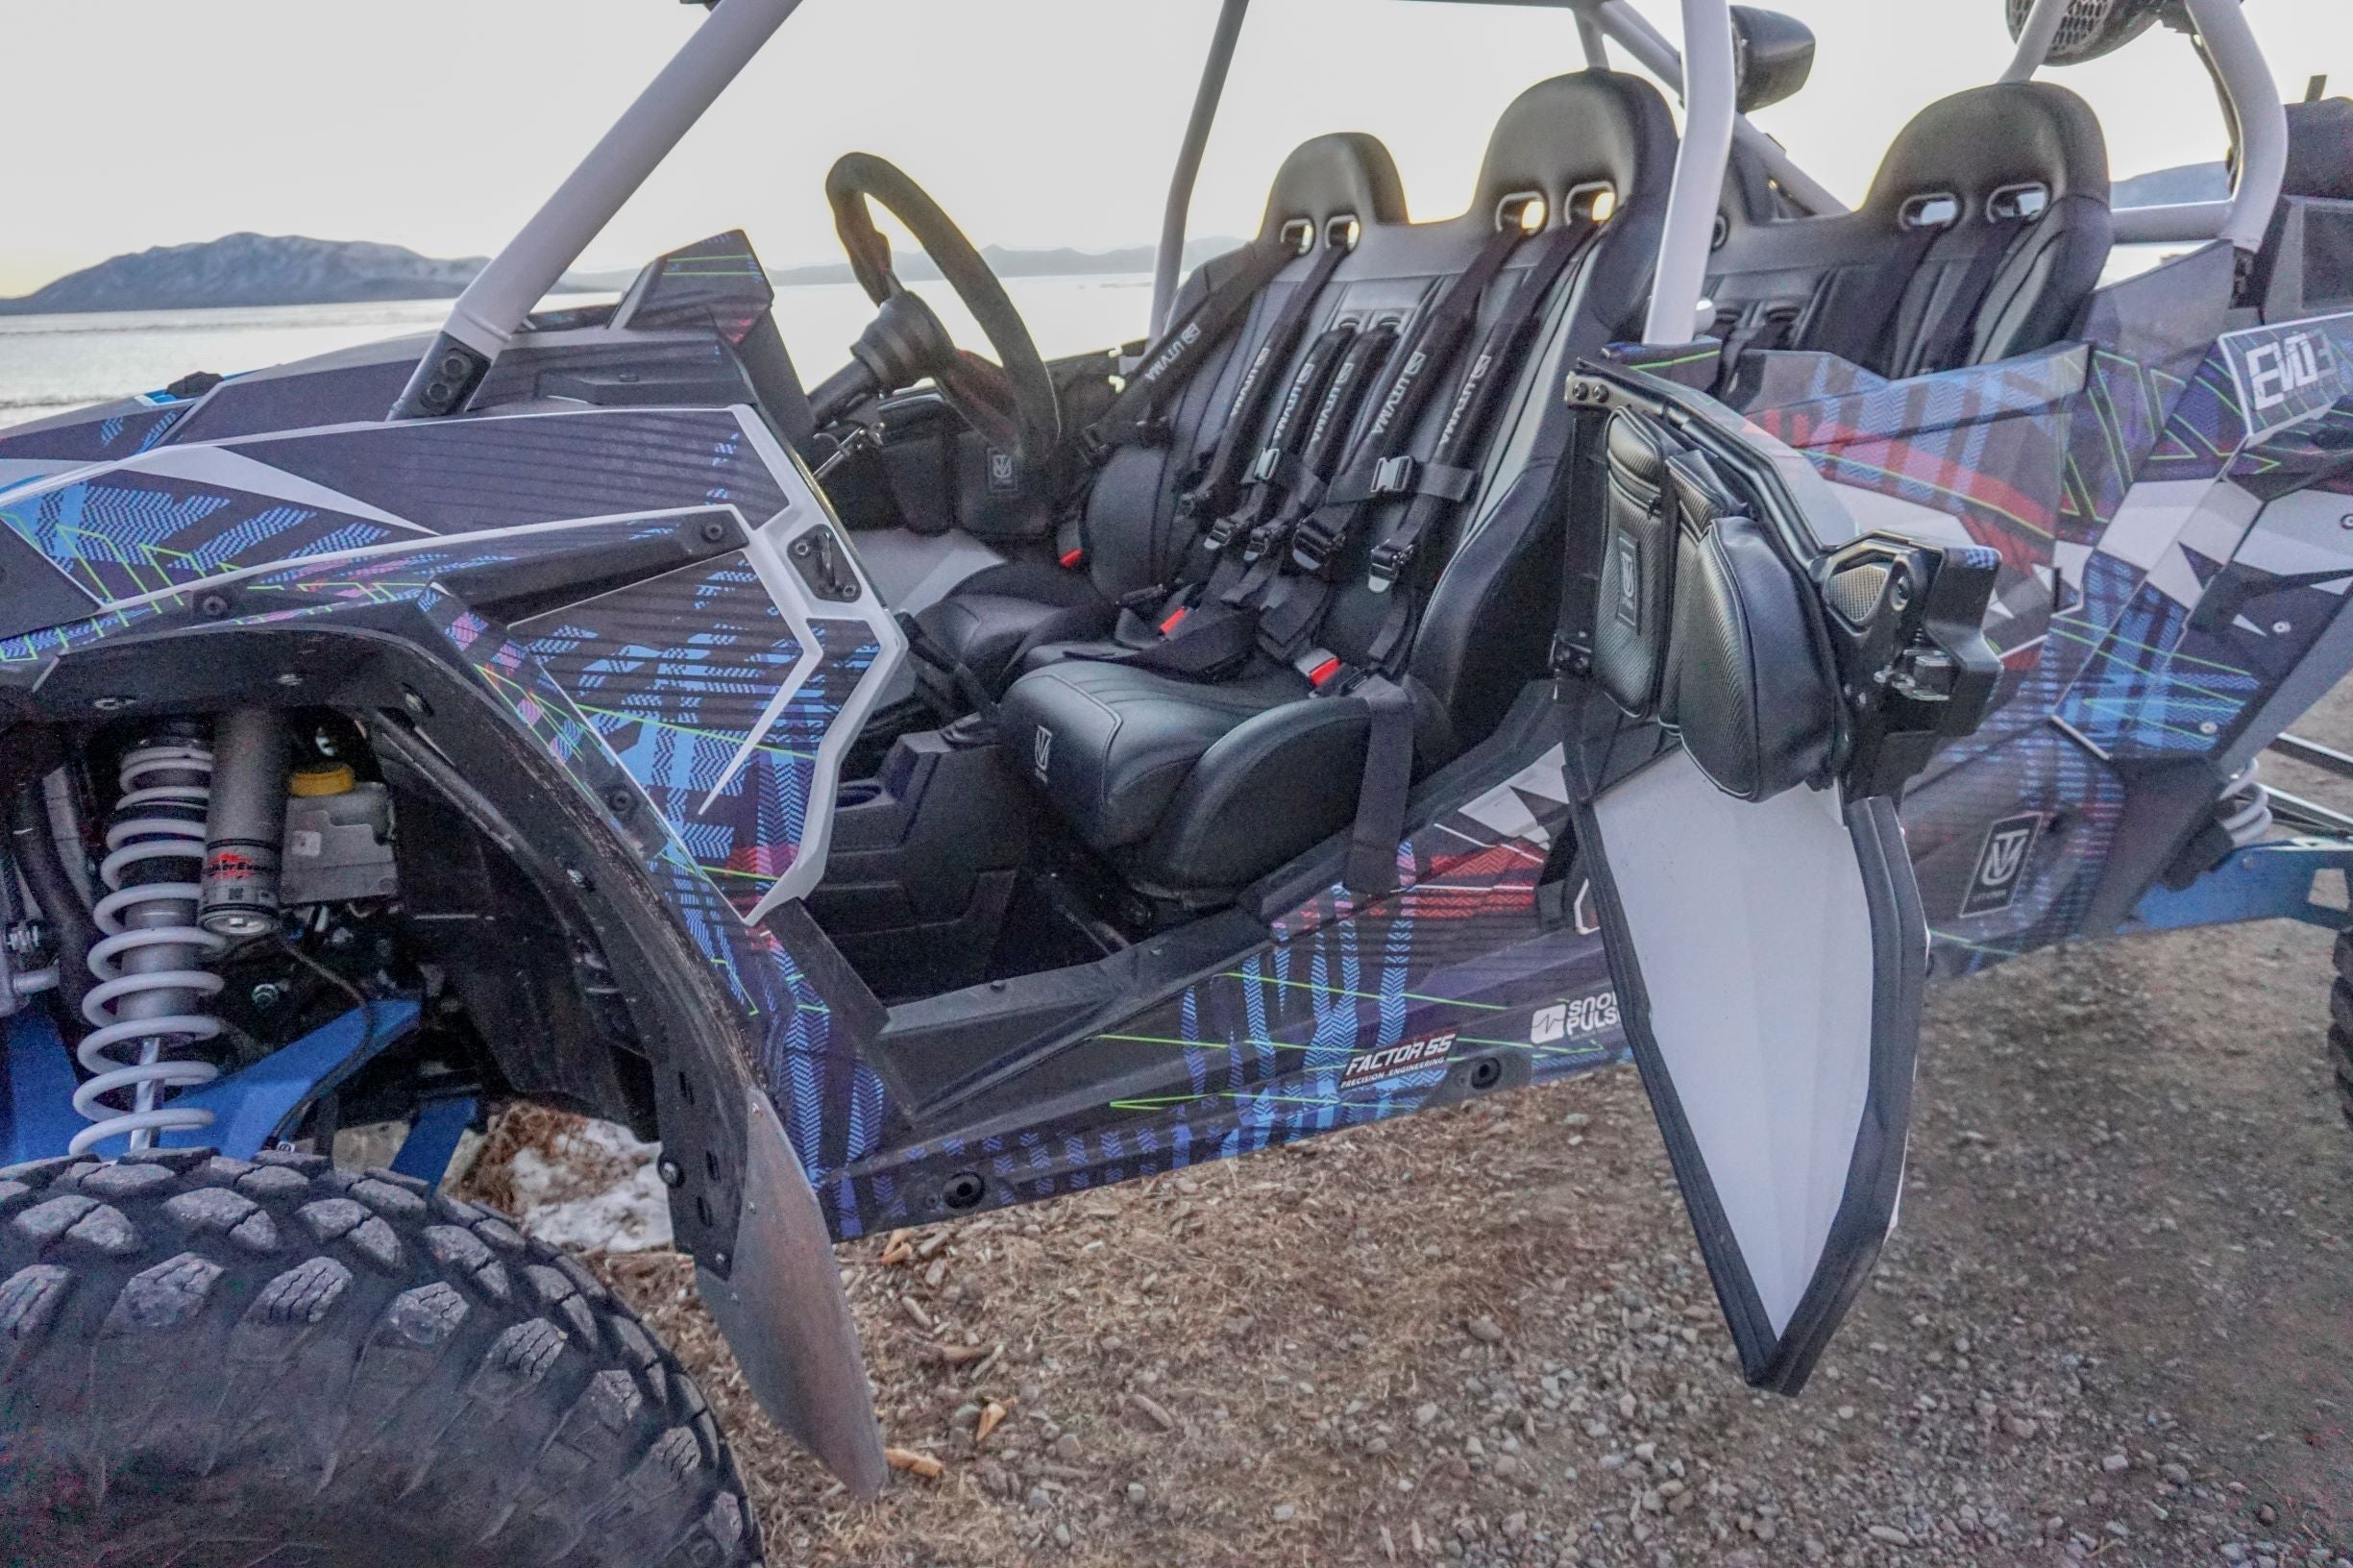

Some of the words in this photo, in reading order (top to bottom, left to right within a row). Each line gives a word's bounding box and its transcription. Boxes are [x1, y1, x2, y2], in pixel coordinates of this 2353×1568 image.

[1144, 340, 1185, 381] UTVMA
[1311, 386, 1341, 443] UTVMA
[1370, 377, 1411, 435] UTVMA
[1438, 382, 1477, 445] UTVMA
[1566, 1006, 1621, 1036] PULS
[1340, 1071, 1385, 1090] PRECISION
[1388, 1057, 1445, 1076] ENGINEERING
[1345, 1041, 1424, 1076] FACTOR
[1423, 1033, 1456, 1057] 55
